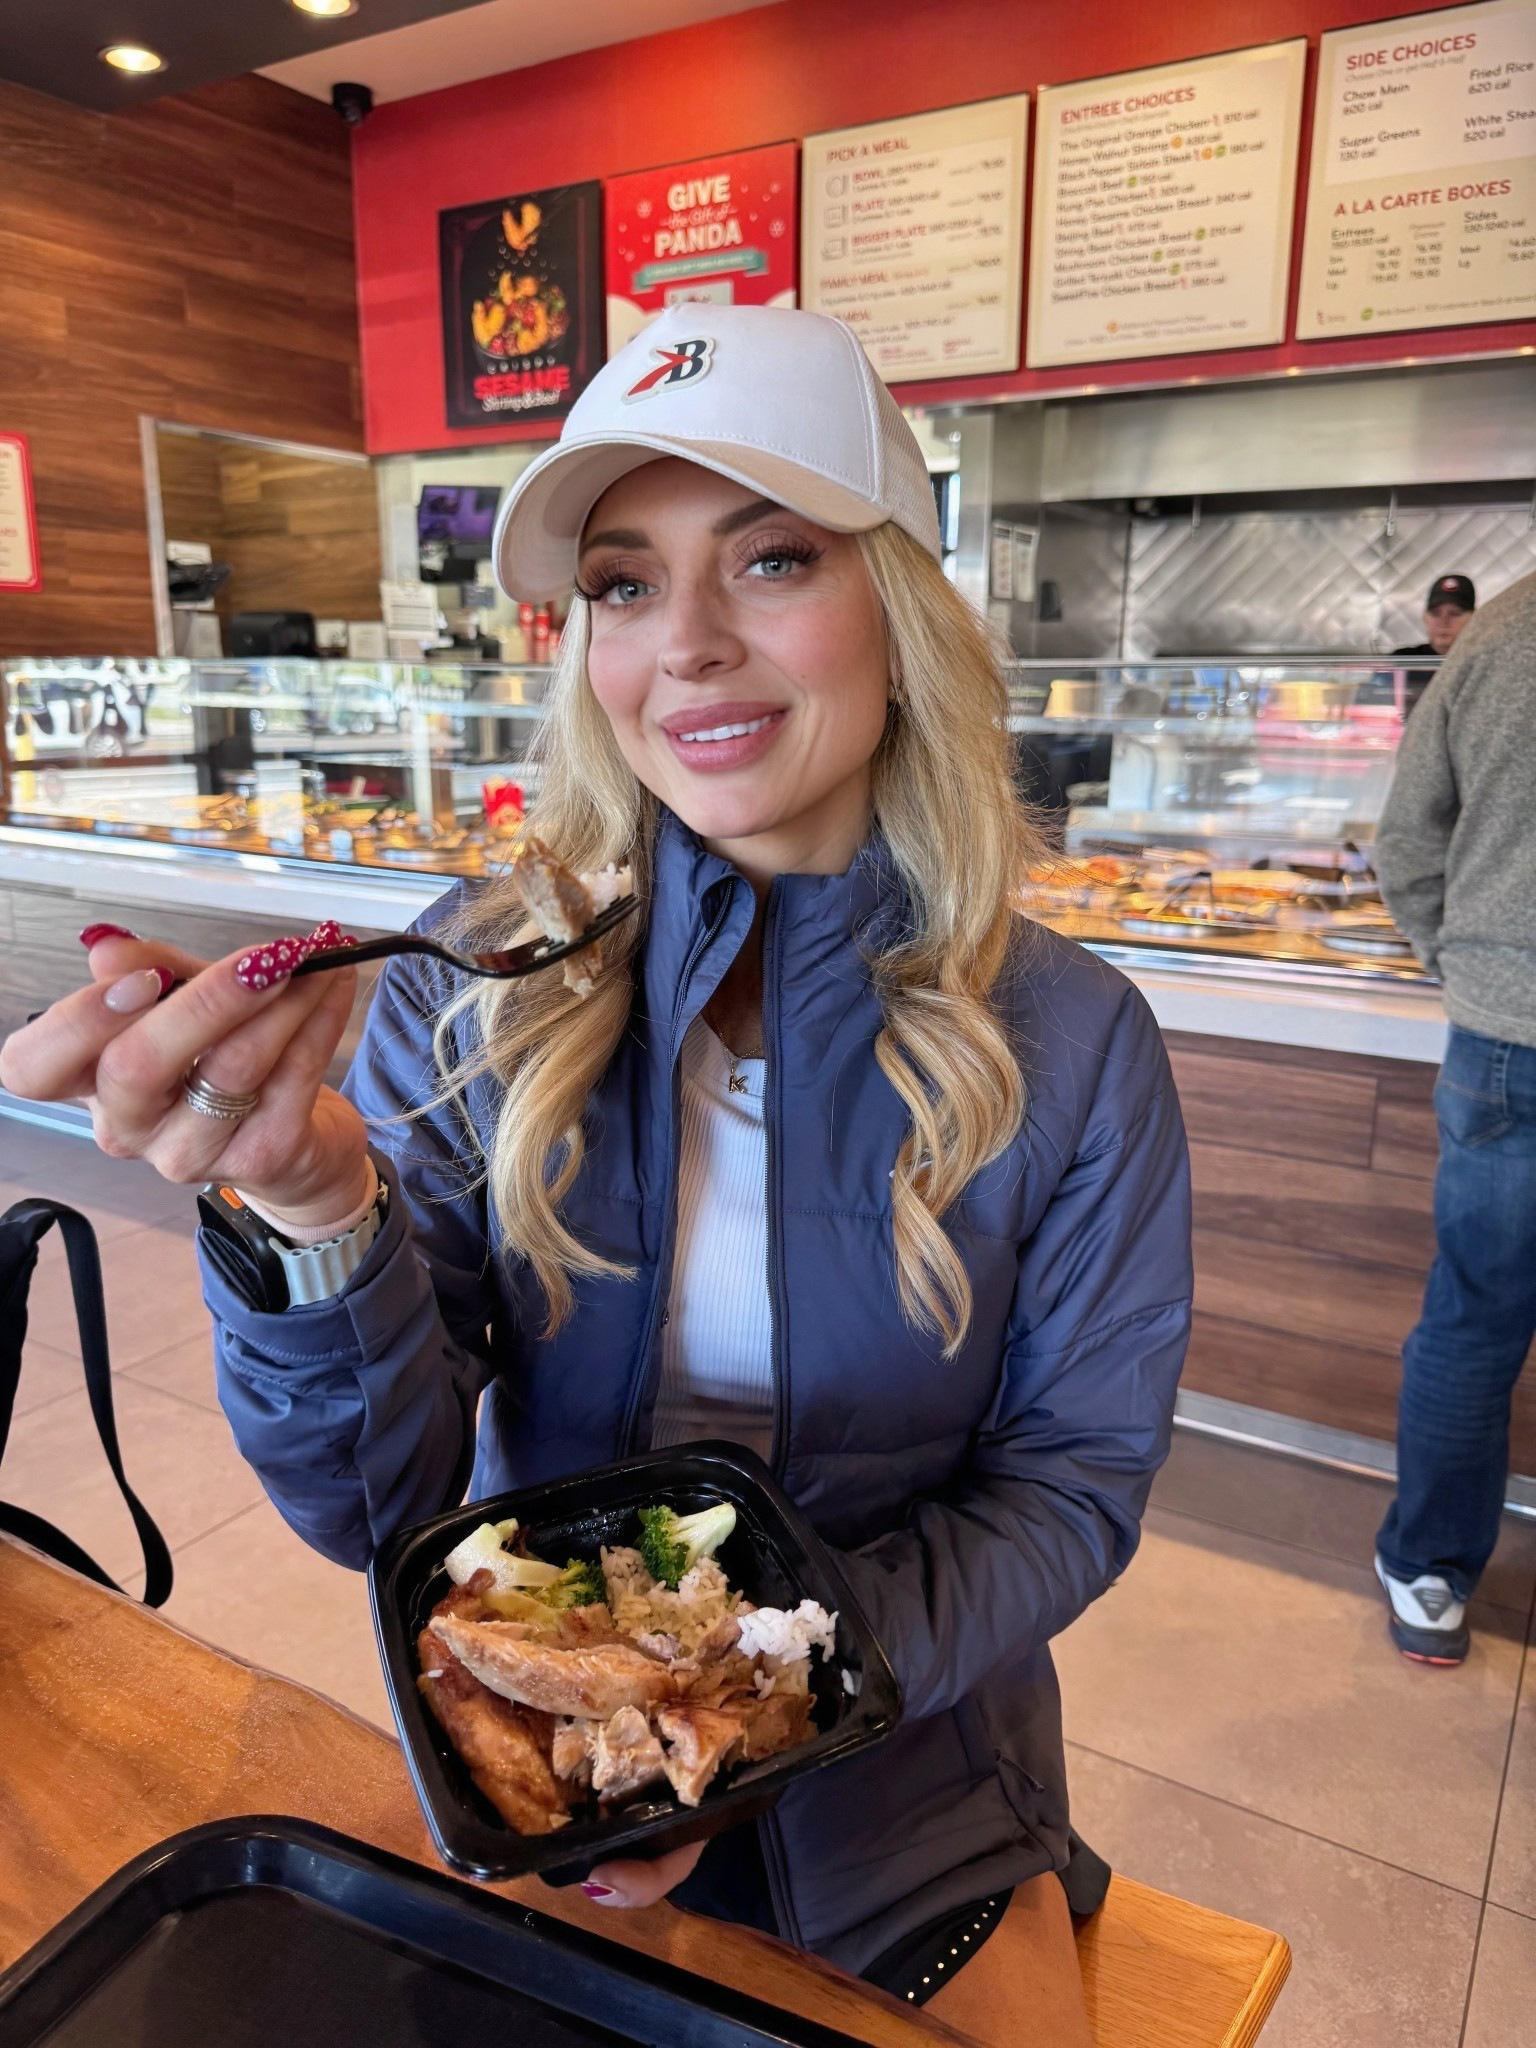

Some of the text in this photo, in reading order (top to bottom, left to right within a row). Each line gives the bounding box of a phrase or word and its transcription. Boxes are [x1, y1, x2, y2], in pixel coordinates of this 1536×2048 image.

[1346, 33, 1477, 70] SIDE CHOICES
[1470, 61, 1534, 80] Fried Rice
[1343, 83, 1410, 103] Chow Mein
[1494, 78, 1511, 91] cal
[1060, 99, 1121, 125] ENTREE
[1124, 86, 1196, 112] CHOICES
[1464, 114, 1502, 128] White
[1339, 128, 1421, 149] Super Greens
[667, 174, 732, 212] GIVE
[1333, 178, 1512, 217] A LA CARTE BOXES
[1463, 210, 1499, 224] Sides
[654, 218, 743, 258] PANDA
[474, 364, 571, 400] SESAME
[729, 1075, 748, 1093] K
